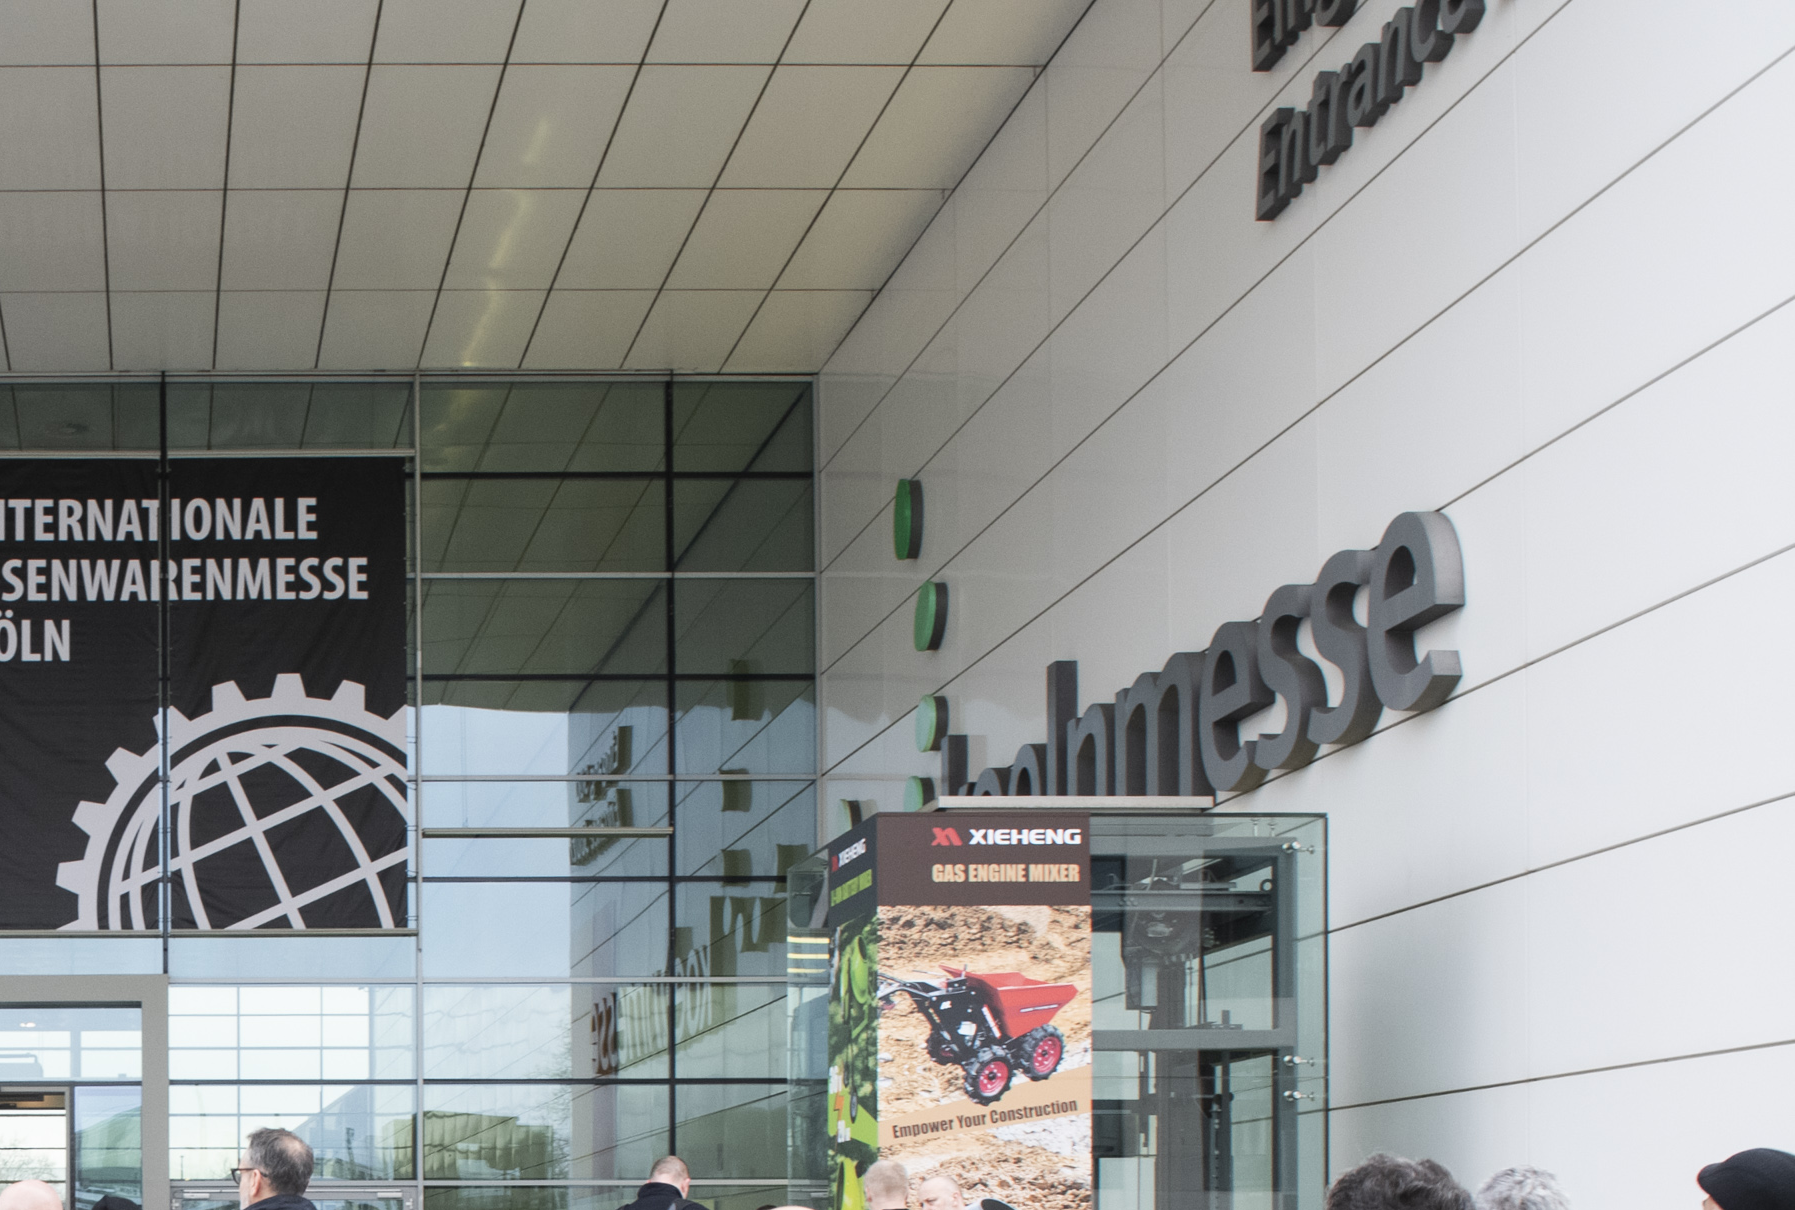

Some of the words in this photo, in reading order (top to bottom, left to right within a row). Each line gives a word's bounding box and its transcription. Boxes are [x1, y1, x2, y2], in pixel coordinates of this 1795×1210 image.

[941, 511, 1465, 796] lnmesse
[968, 828, 1083, 845] XIEHENG
[932, 863, 966, 883] GAS
[968, 863, 1027, 883] ENGINE
[1028, 863, 1081, 883] MIXER
[892, 1119, 954, 1139] Empower
[956, 1113, 987, 1129] Your
[990, 1100, 1078, 1124] Construction
